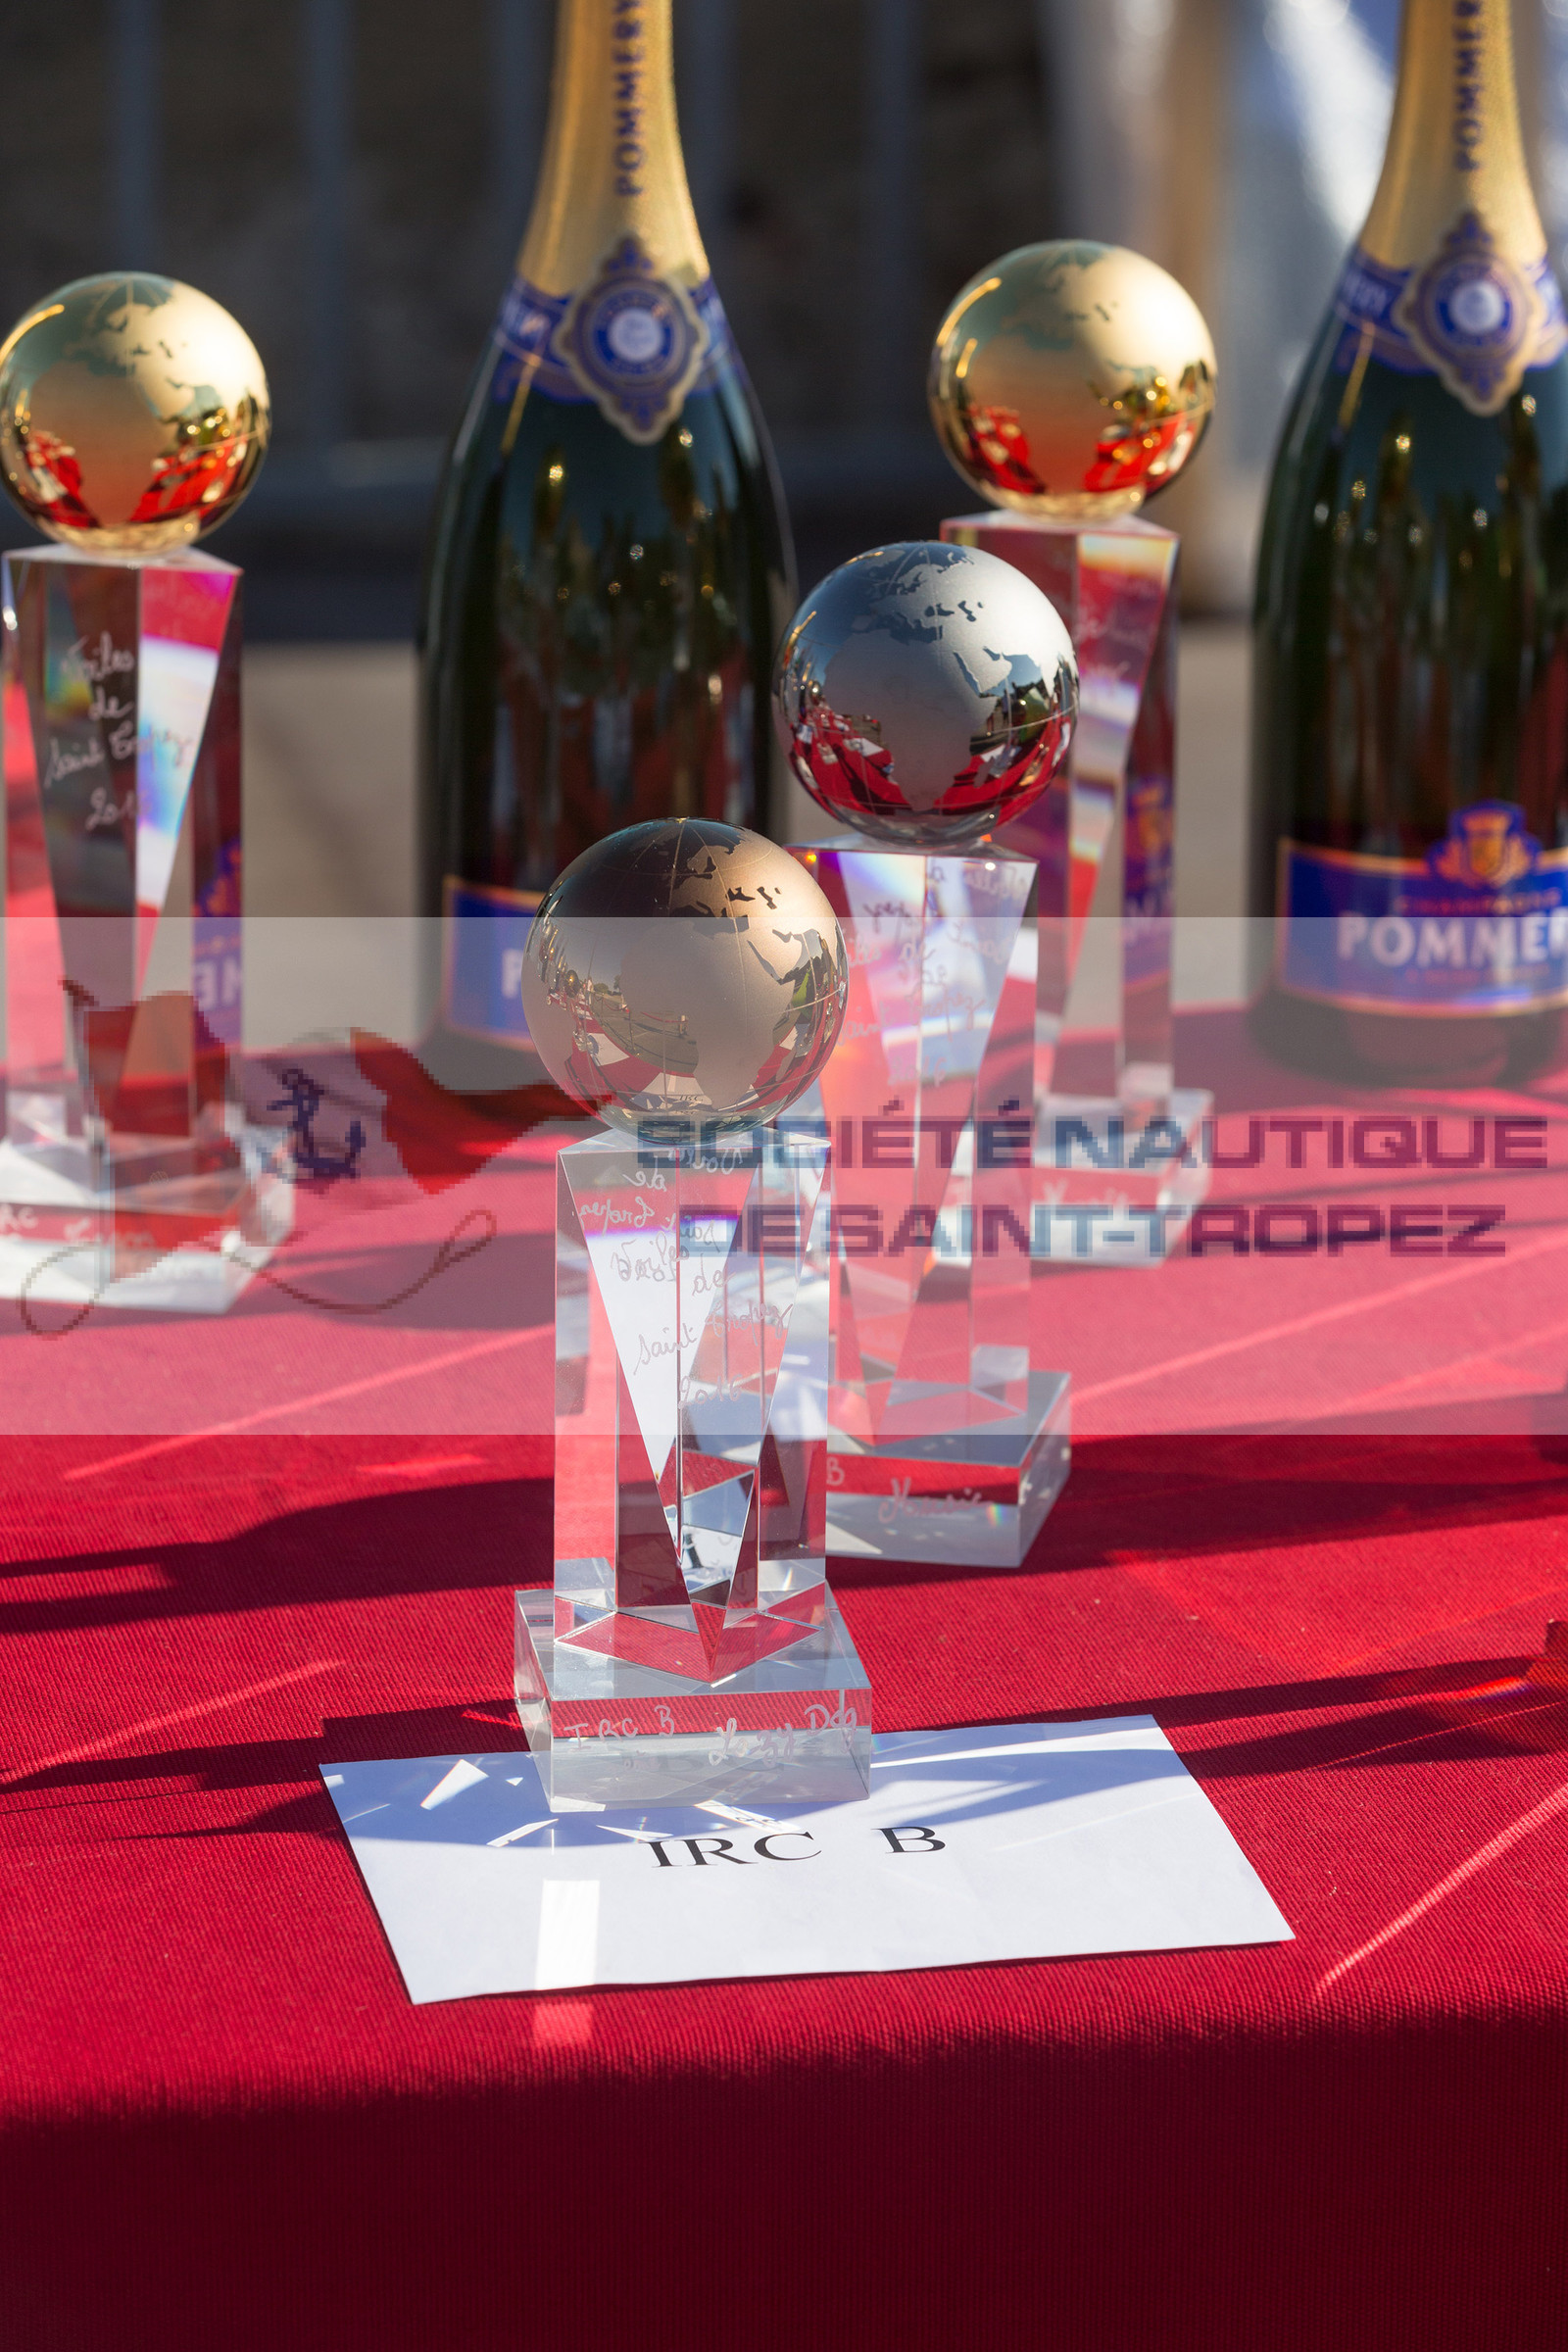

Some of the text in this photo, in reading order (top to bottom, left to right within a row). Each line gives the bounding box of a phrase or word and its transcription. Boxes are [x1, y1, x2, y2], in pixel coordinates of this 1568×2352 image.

[691, 1252, 737, 1296] de
[678, 1373, 743, 1409] 2016
[564, 1718, 638, 1752] IRC
[654, 1705, 675, 1738] B
[639, 1826, 947, 1868] IRC B
